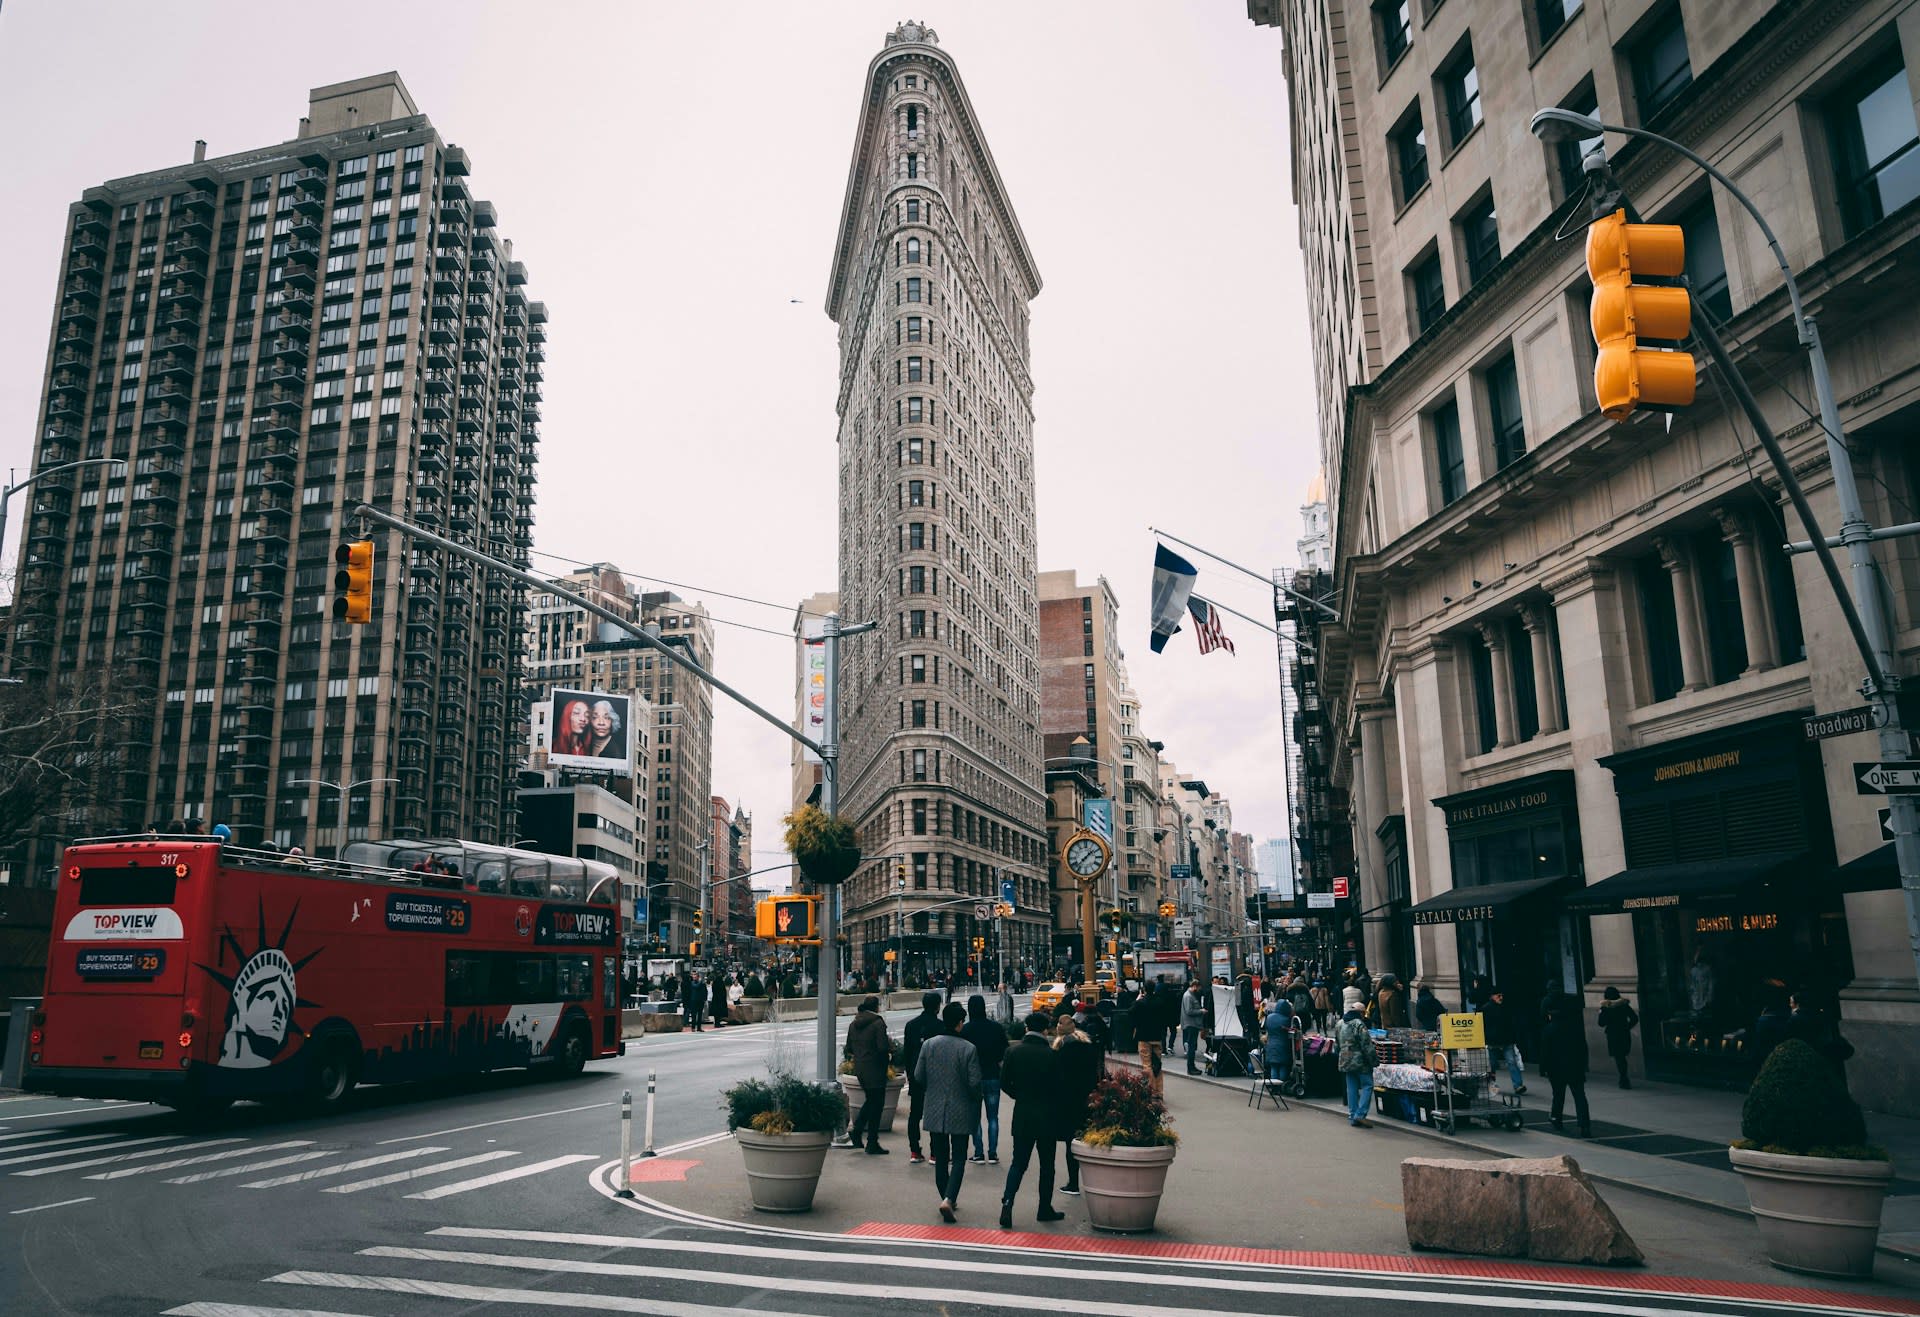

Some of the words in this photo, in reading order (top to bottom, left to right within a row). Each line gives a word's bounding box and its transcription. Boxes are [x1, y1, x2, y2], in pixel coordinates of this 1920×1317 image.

[1805, 712, 1867, 738] Broadway
[1870, 772, 1900, 785] ONE
[1453, 807, 1474, 822] FINE
[1476, 798, 1517, 817] ITALIAN
[1520, 791, 1547, 808] FOOD
[160, 853, 179, 865] 317
[395, 901, 408, 911] BUY
[409, 903, 433, 913] TICKETS
[433, 905, 442, 914] AT
[1414, 909, 1453, 924] EATALY
[86, 954, 99, 962] BUY
[99, 954, 123, 962] TICKETS
[1451, 1017, 1474, 1027] Lego
